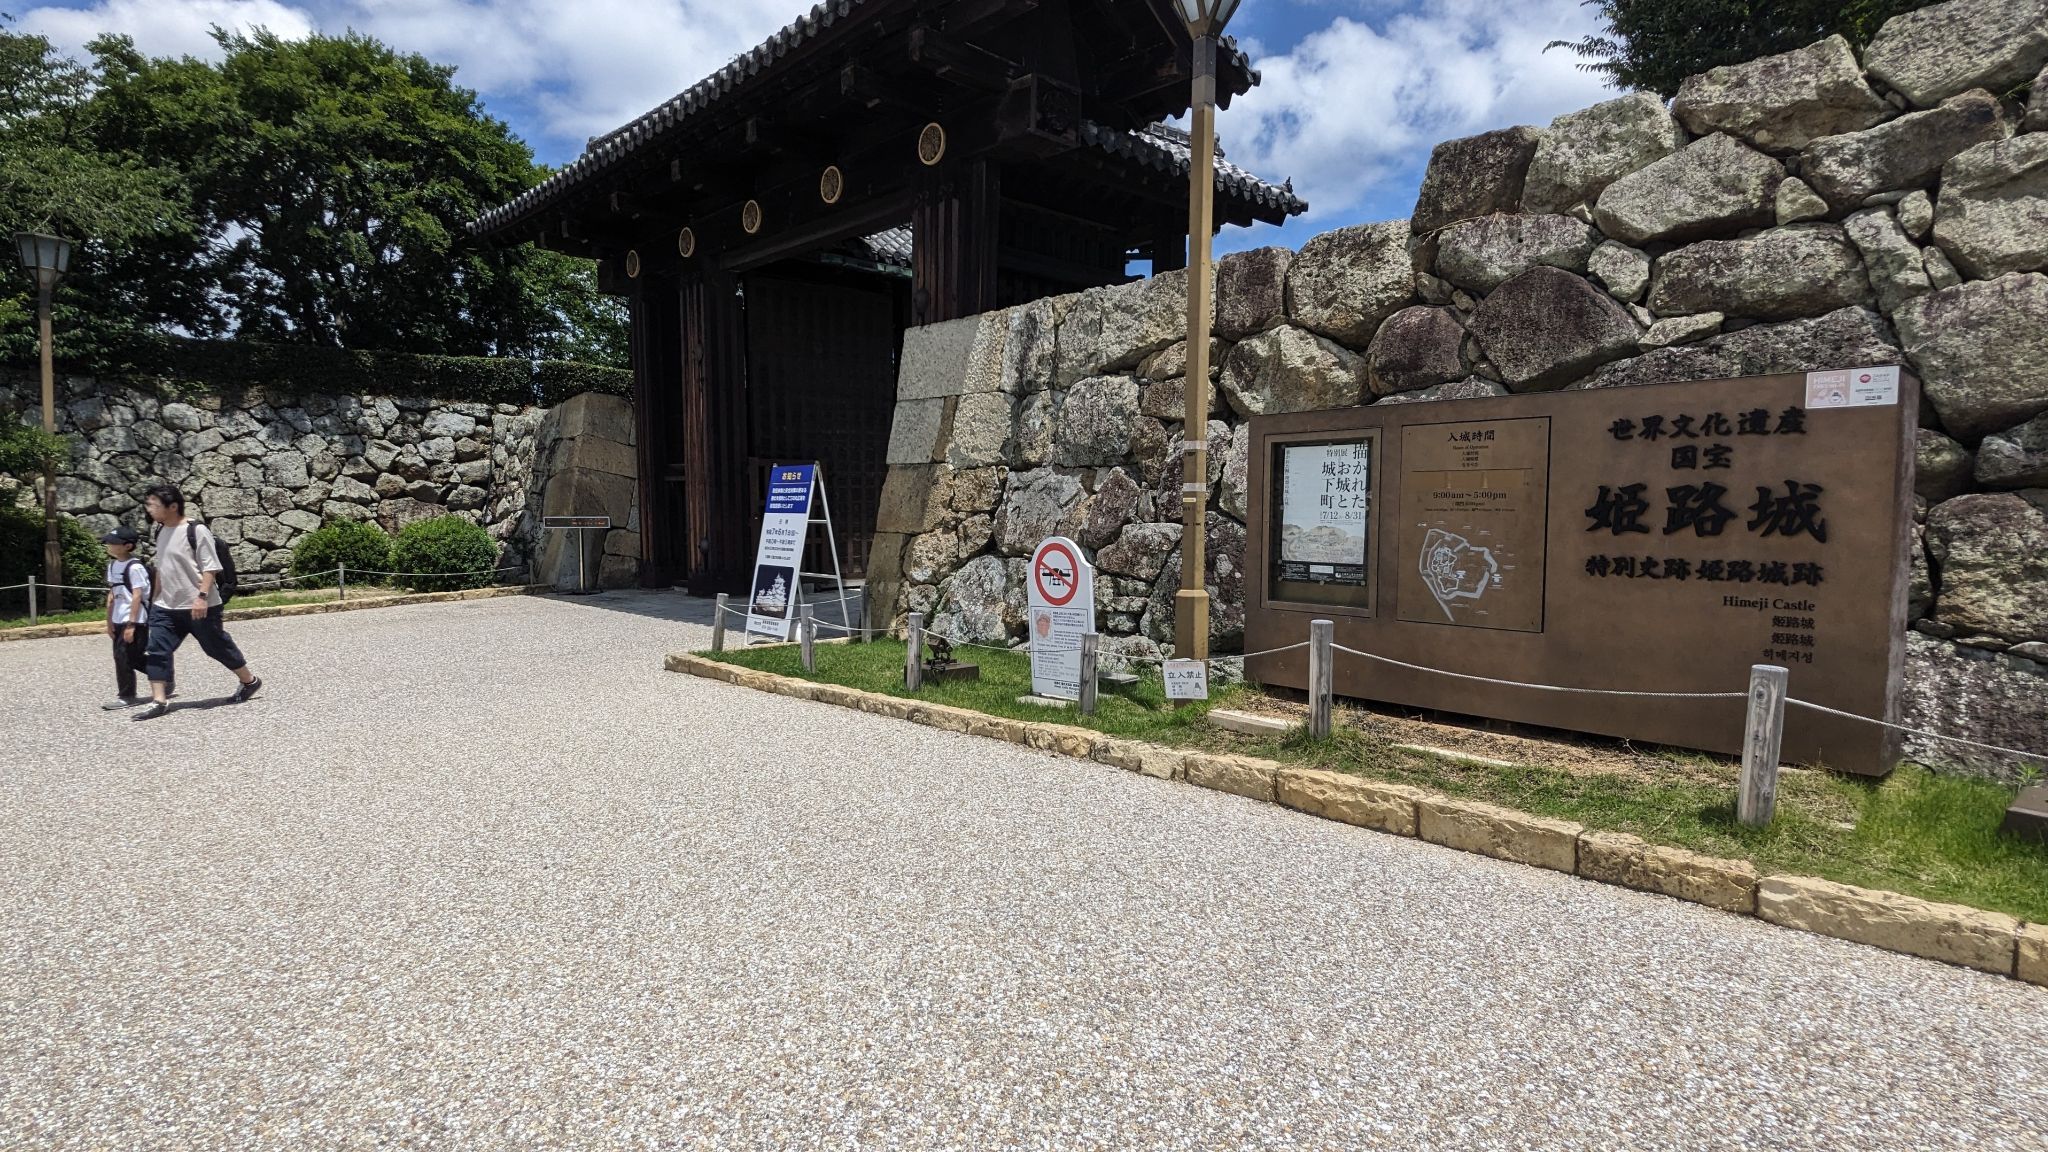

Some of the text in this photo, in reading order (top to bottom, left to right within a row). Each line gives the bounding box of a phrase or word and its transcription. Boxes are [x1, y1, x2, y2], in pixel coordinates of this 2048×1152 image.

[1608, 407, 1807, 441] 世界文化遺産
[1447, 430, 1495, 442] 入城時間
[1326, 448, 1348, 457] 特別展
[1671, 444, 1733, 470] 国宝
[782, 472, 802, 480] お知らせ
[1320, 462, 1336, 509] 城下町
[1336, 462, 1351, 508] お城と
[1585, 480, 1827, 543] 姫路城
[1723, 595, 1815, 612] Himeji Castle
[1168, 671, 1203, 679] 立入禁止
